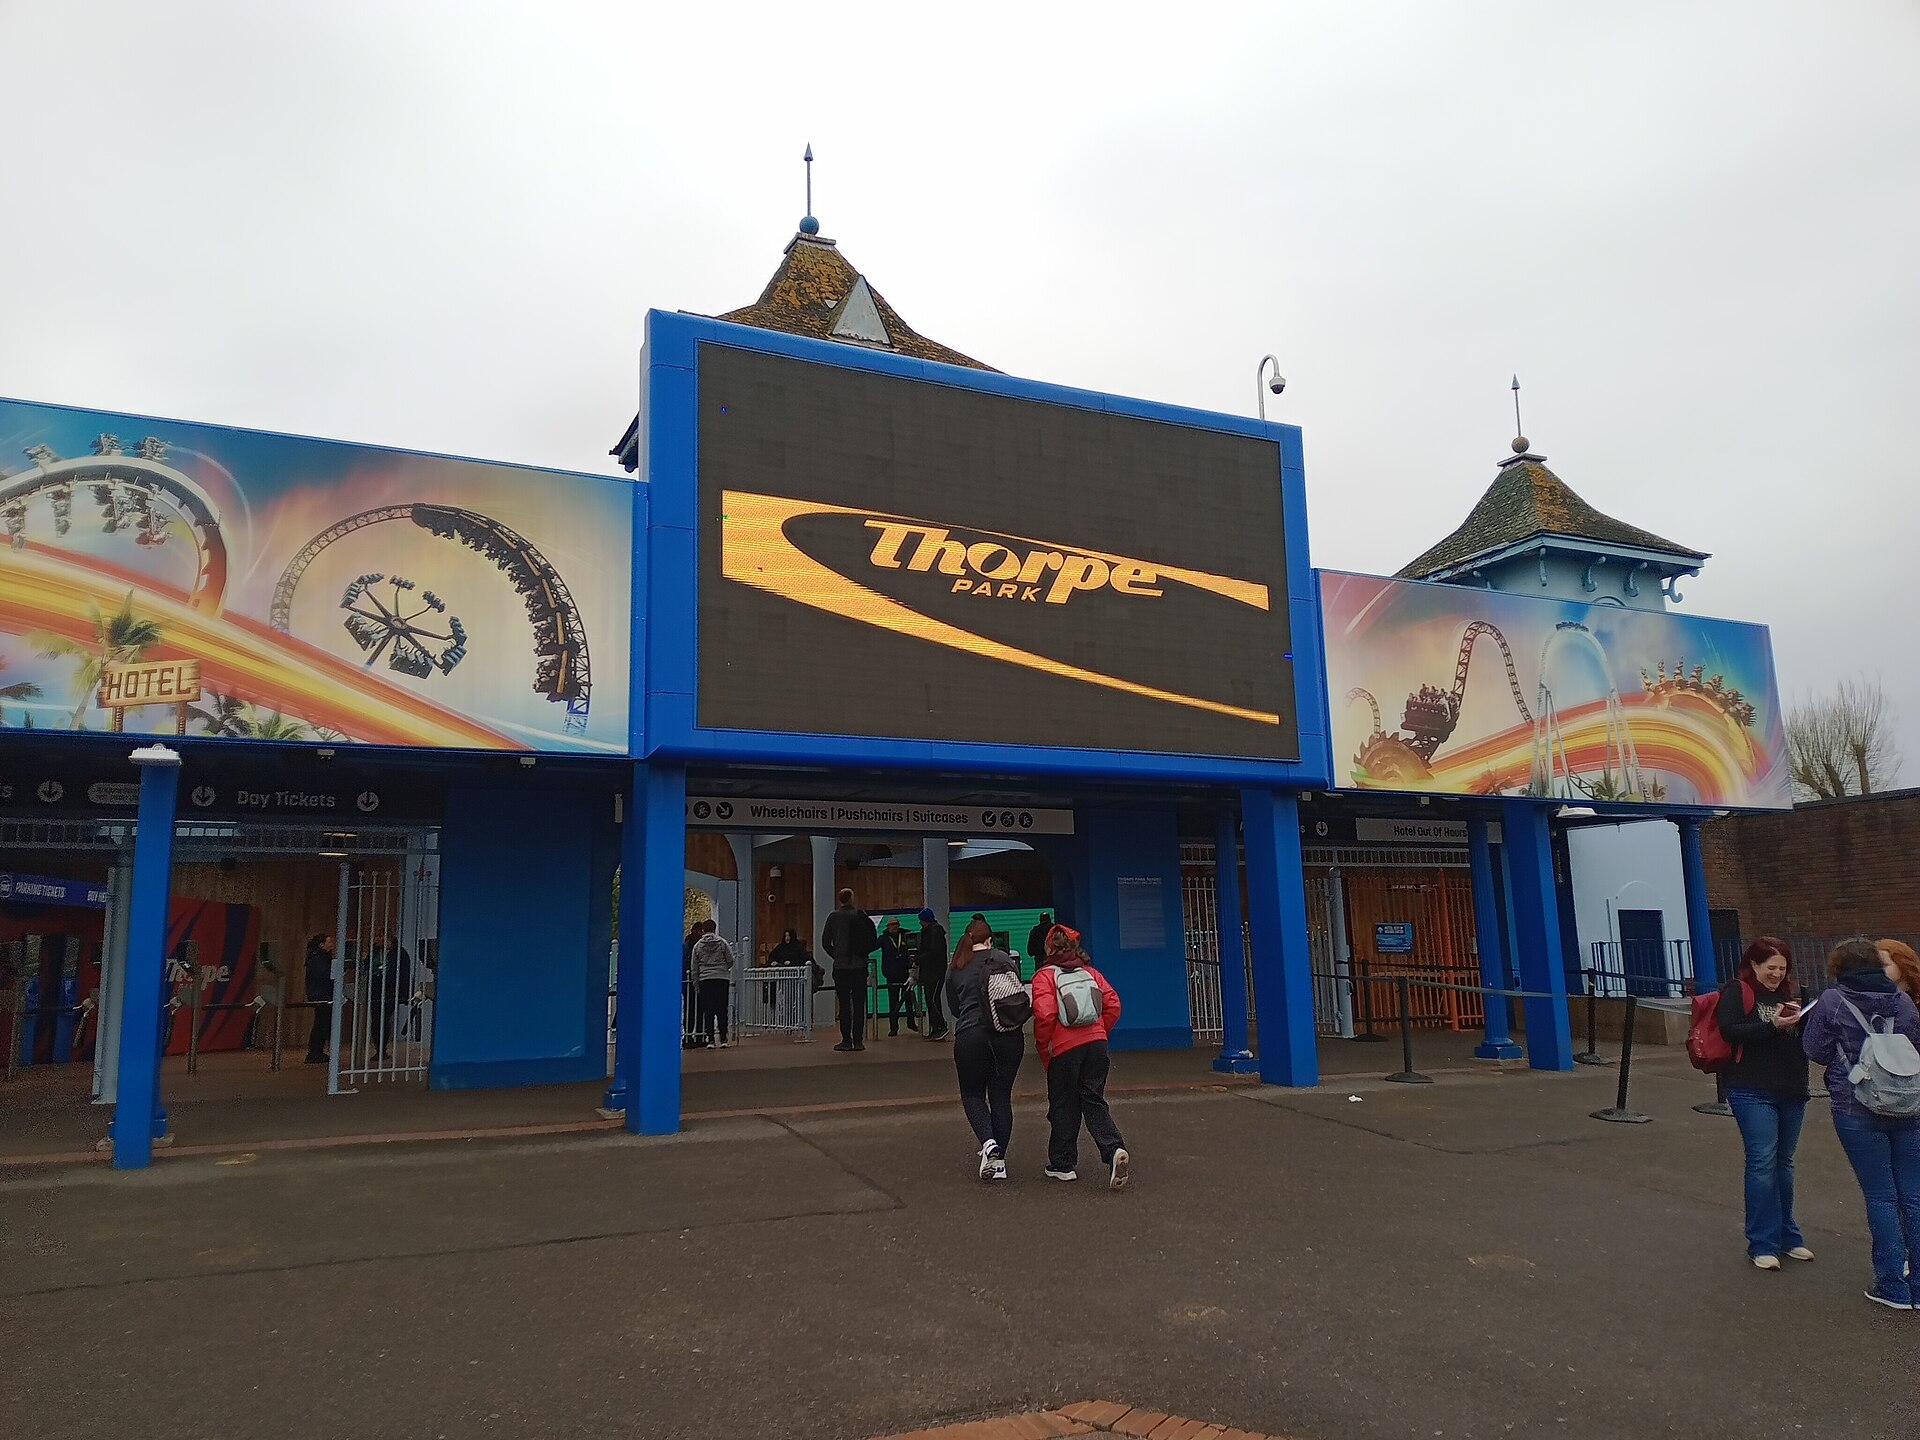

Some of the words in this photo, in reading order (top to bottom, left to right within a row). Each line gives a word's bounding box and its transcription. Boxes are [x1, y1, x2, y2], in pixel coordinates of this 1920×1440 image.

[863, 519, 1165, 605] Thorpe
[952, 578, 1040, 603] PARK
[105, 666, 192, 701] HOTEL
[237, 790, 270, 808] Day
[275, 791, 337, 808] Tickets
[750, 805, 828, 820] Wheelchairs
[837, 807, 904, 822] Pushchairs
[912, 810, 969, 824] Suitcases
[1393, 825, 1416, 837] Hotel
[1417, 826, 1433, 838] Out
[1433, 826, 1443, 838] Of
[1444, 826, 1468, 838] Hours
[14, 881, 41, 897] PARKING
[41, 884, 67, 898] TICKETS
